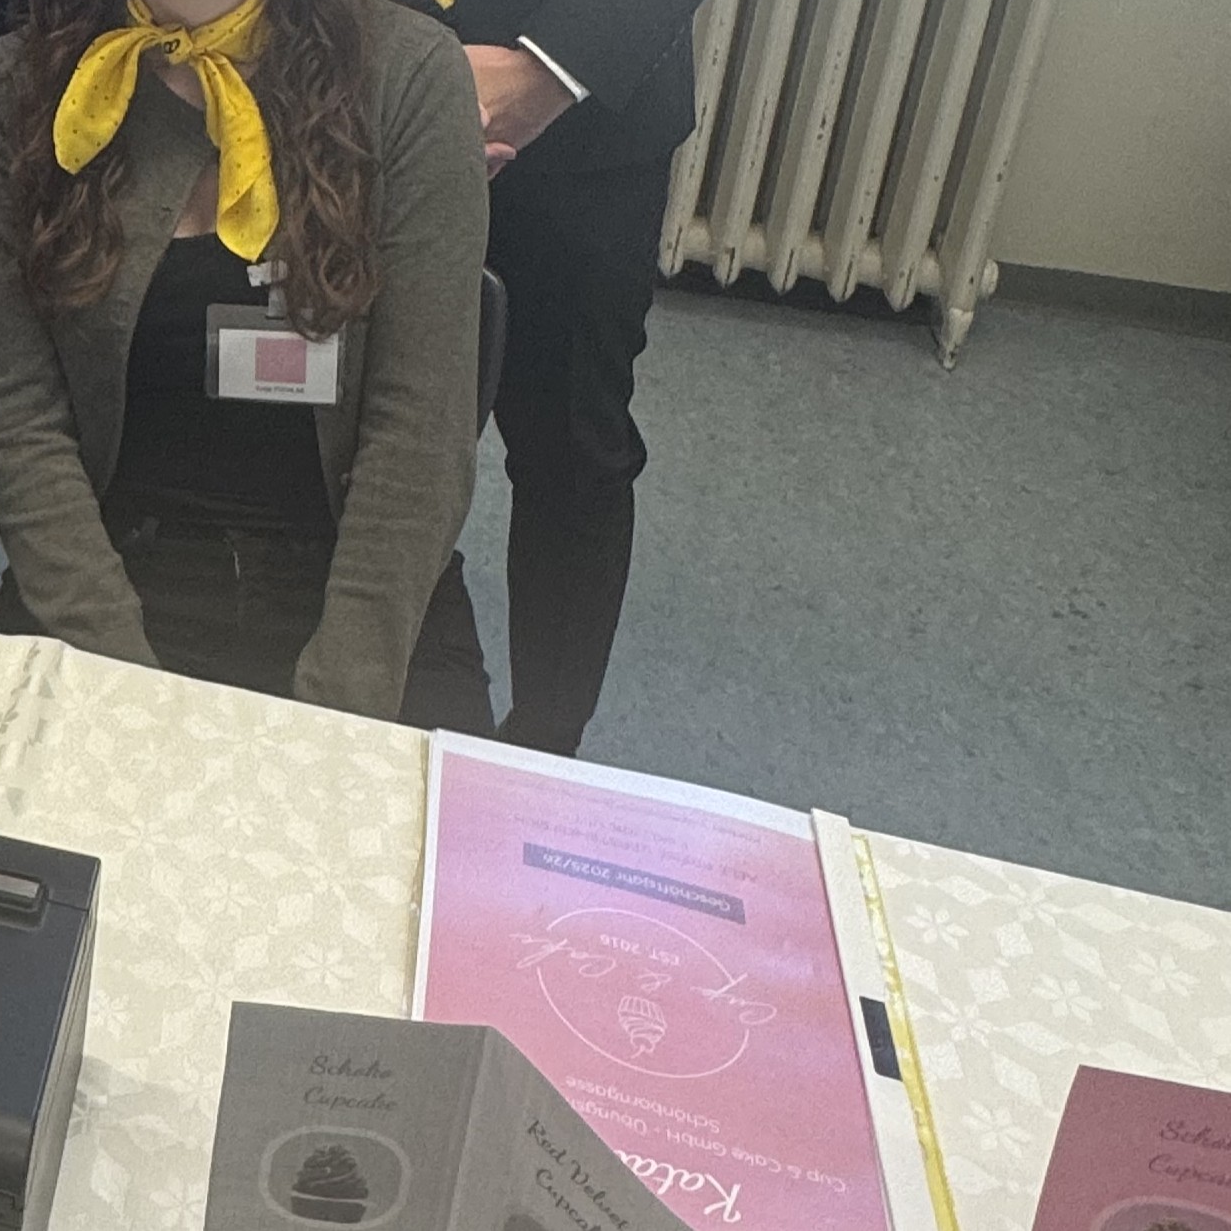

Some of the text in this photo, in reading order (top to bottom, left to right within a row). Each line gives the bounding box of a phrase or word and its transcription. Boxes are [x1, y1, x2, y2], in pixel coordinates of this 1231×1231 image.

[542, 853, 732, 912] Geschäftsjahr 2025/26
[508, 933, 778, 1026] Cup & Cake
[303, 1086, 398, 1111] Cupcake
[565, 1075, 721, 1134] Schönborngasse
[666, 1128, 728, 1158] GmbH
[730, 1146, 783, 1174] Cake
[527, 1120, 629, 1230] Red Velvet
[613, 1148, 743, 1224] Kata
[786, 1165, 803, 1180] &
[806, 1170, 848, 1194] Cup
